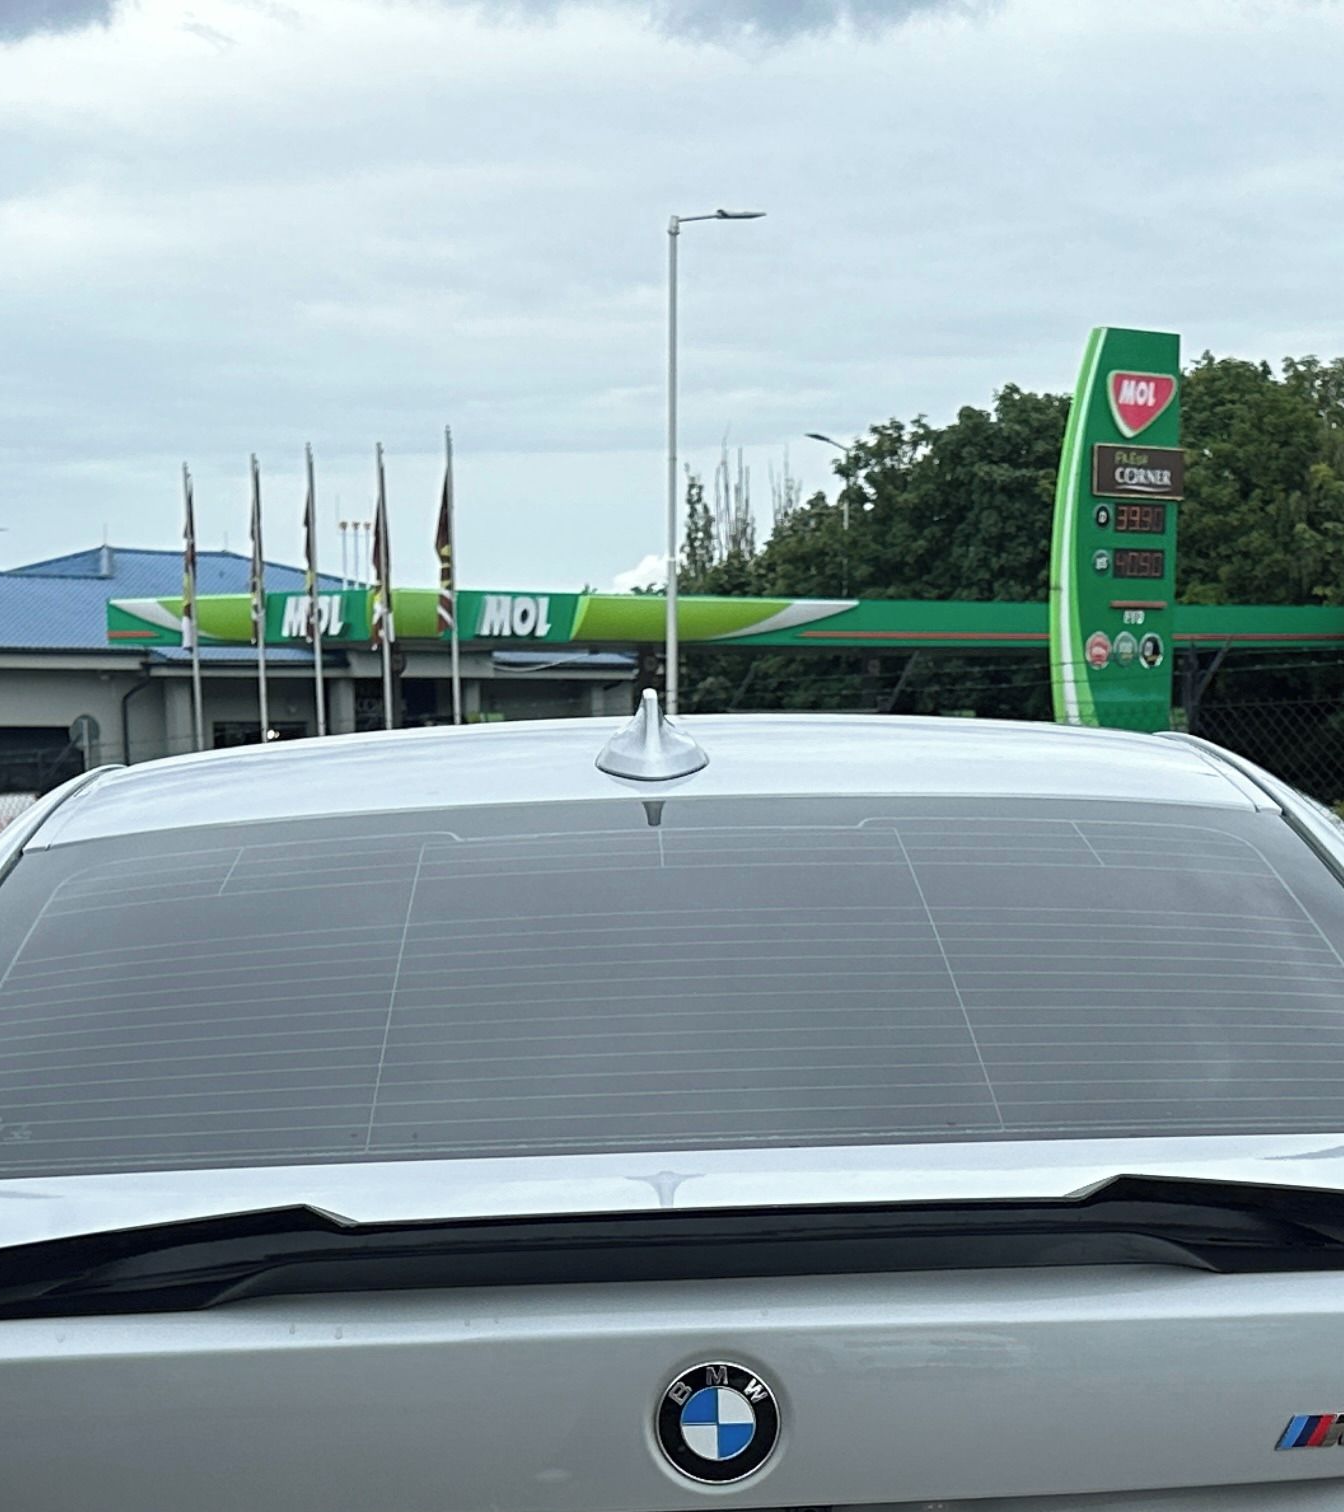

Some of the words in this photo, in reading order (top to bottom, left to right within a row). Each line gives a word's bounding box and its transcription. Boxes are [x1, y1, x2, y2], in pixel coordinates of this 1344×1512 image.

[1118, 379, 1157, 407] MOL
[1114, 466, 1172, 486] CORNER
[479, 595, 552, 637] MOL
[668, 1365, 768, 1407] BMW
